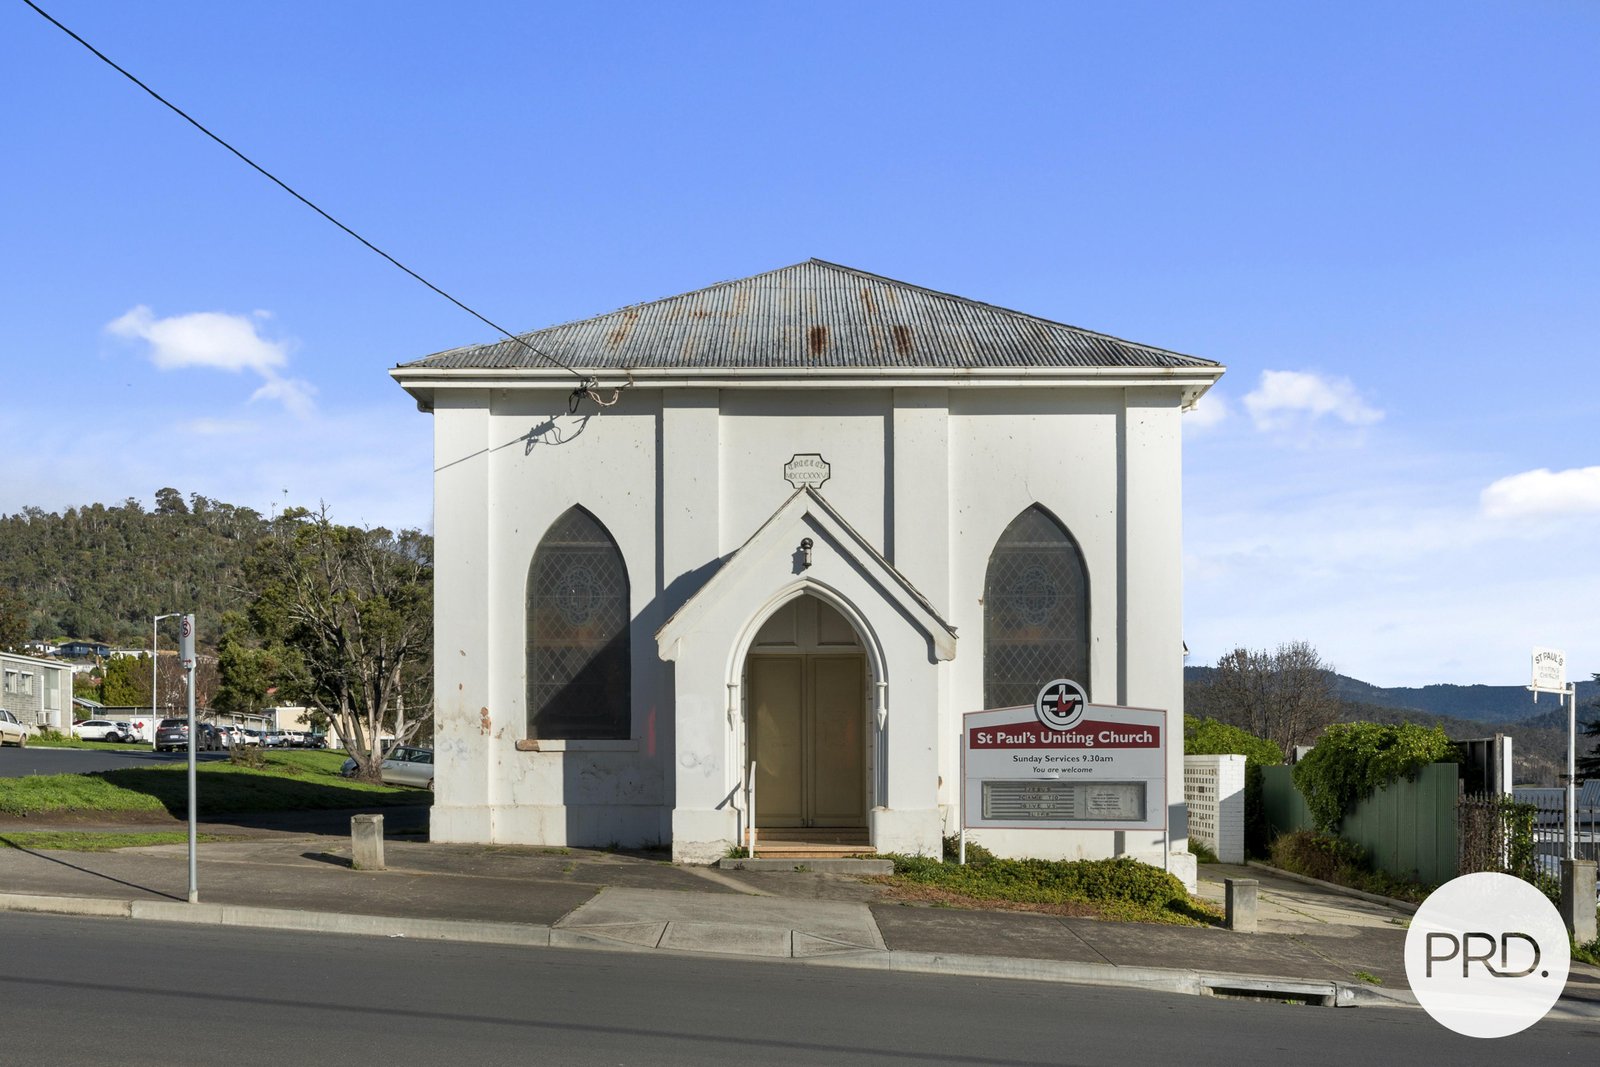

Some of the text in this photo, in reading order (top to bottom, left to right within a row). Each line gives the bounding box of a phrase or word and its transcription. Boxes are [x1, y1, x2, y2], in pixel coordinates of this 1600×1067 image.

[1535, 653, 1543, 665] ST
[977, 731, 1153, 746] St Paul's Uniting Church
[1013, 755, 1114, 764] Sunday Services 9.30am
[1032, 766, 1045, 774] You
[1061, 766, 1093, 774] welcome
